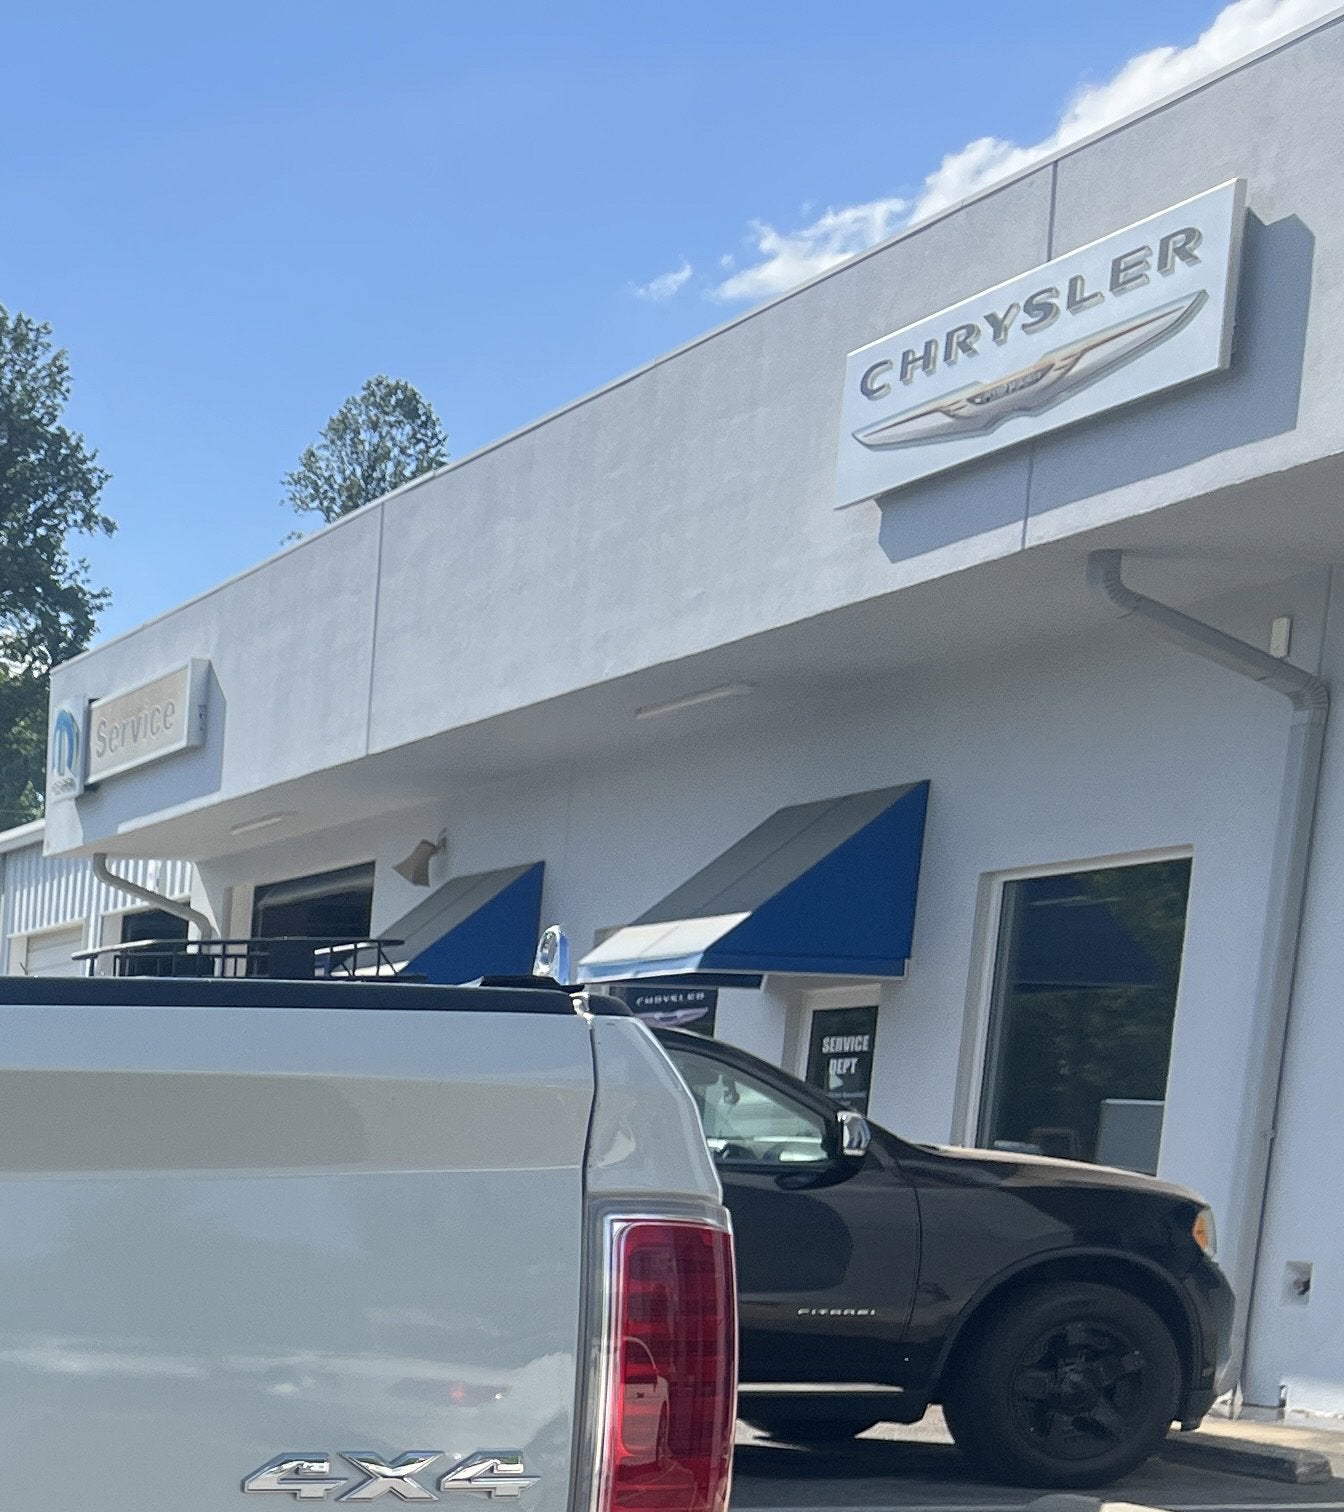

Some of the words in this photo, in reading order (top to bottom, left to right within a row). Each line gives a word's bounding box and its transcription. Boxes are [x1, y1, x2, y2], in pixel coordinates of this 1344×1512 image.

[859, 226, 1203, 401] CHRYSLER
[95, 698, 175, 760] Service
[822, 1034, 870, 1054] SERVICE
[829, 1057, 859, 1075] DEPT
[240, 1450, 542, 1503] 4X4
